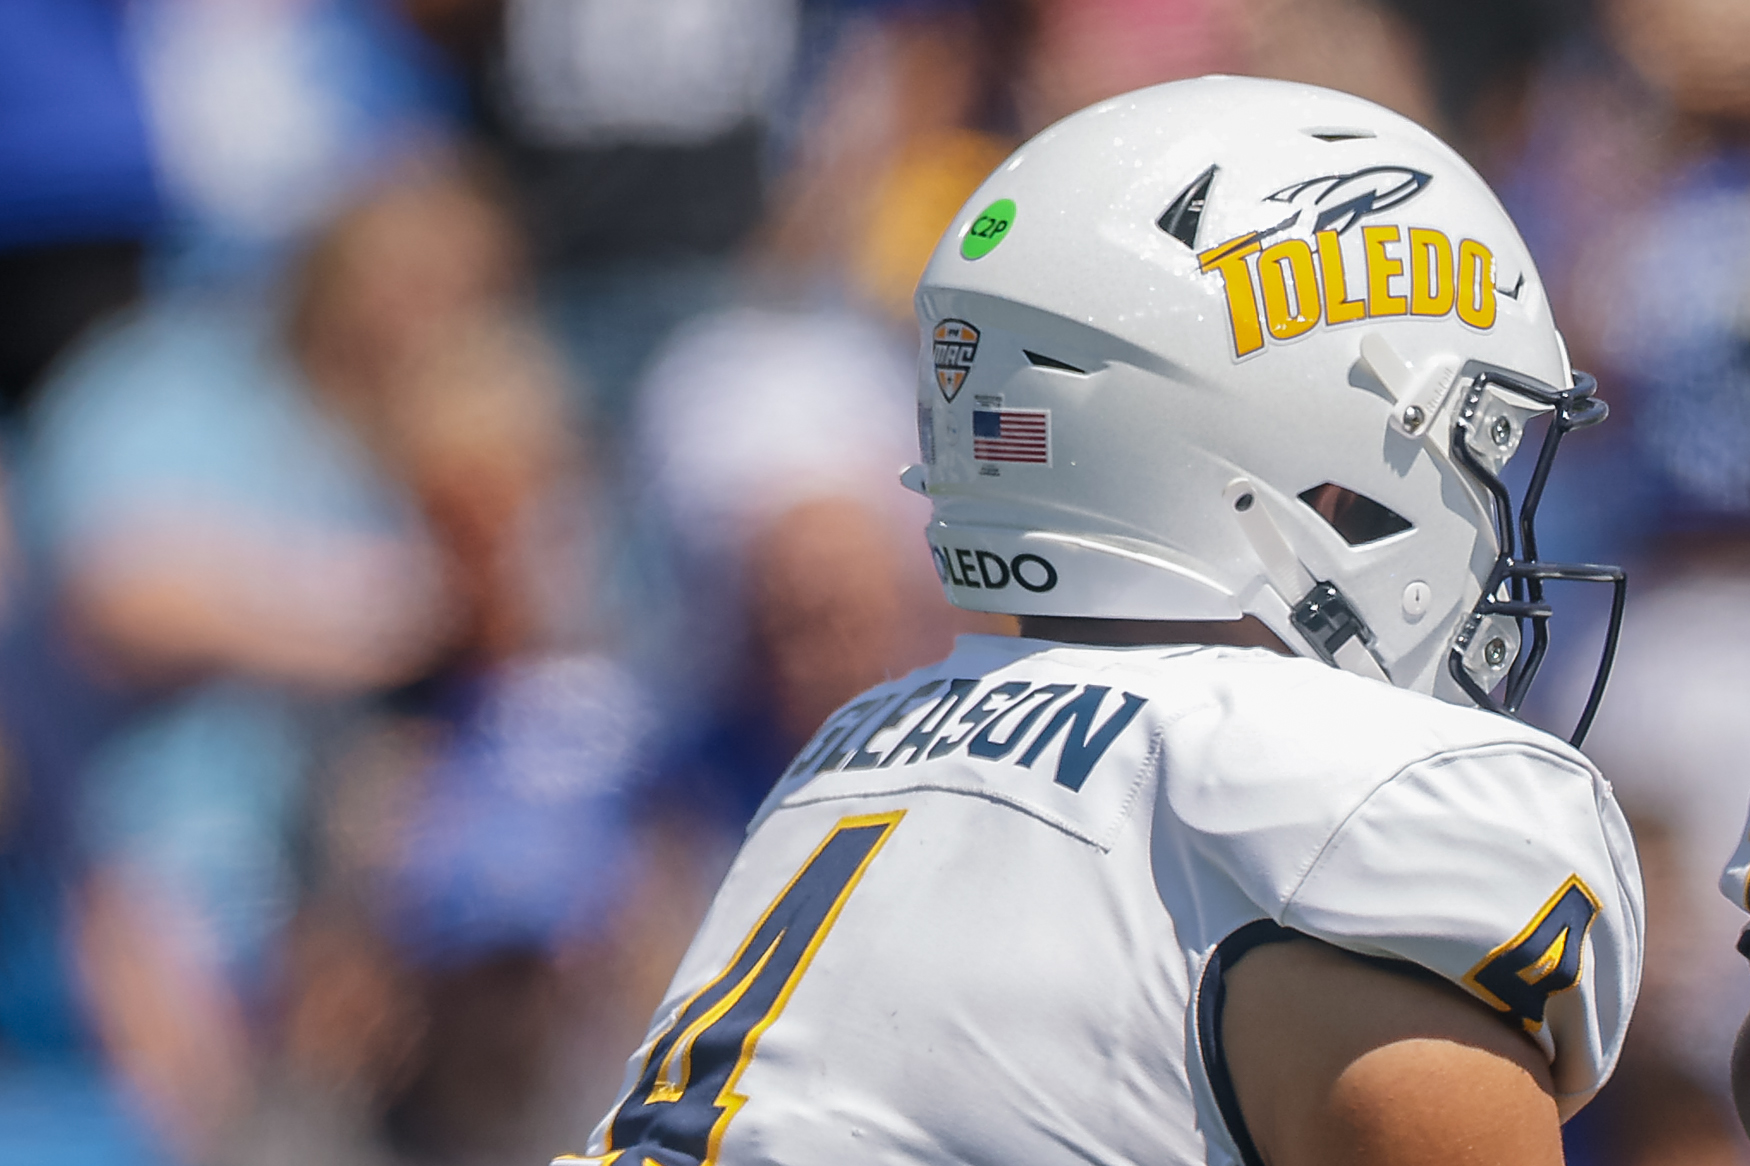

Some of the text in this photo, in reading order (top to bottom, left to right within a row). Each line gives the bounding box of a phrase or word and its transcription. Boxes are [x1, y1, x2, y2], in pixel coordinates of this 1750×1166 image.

[970, 215, 1008, 239] C2P
[1197, 224, 1497, 358] TOLEDO
[1460, 872, 1603, 1033] 4
